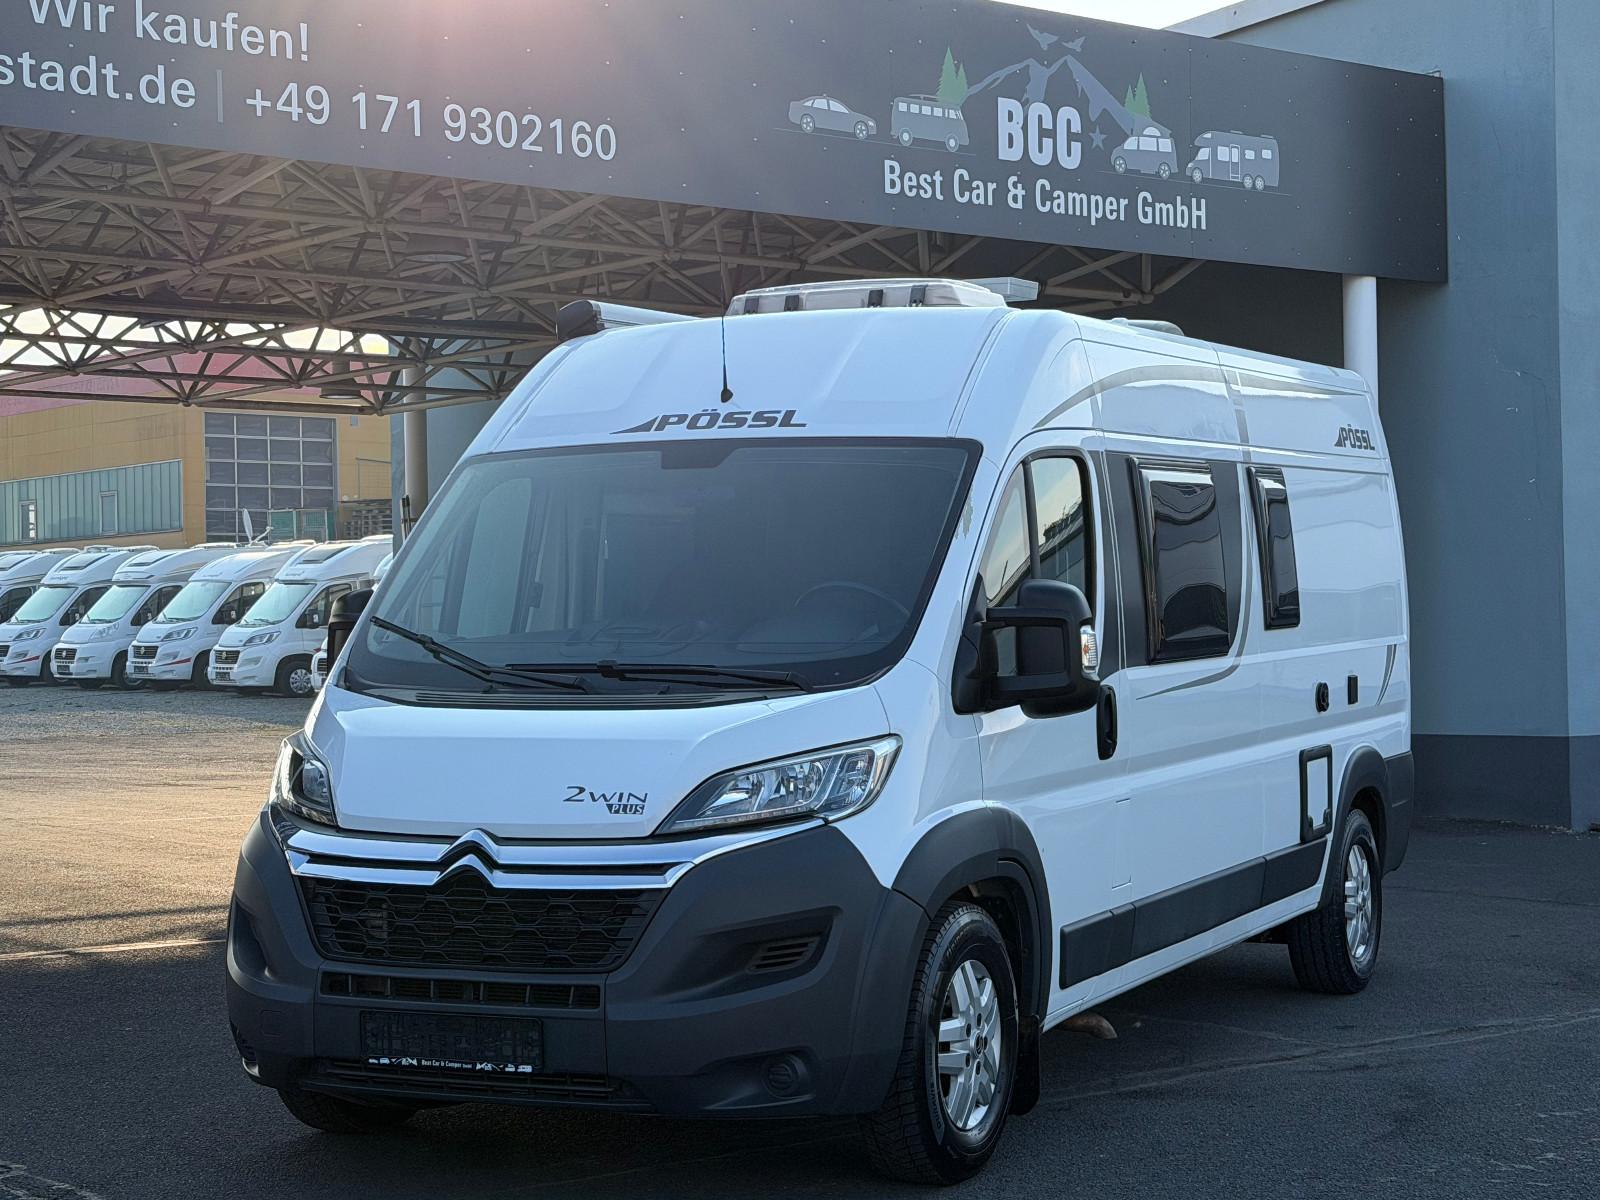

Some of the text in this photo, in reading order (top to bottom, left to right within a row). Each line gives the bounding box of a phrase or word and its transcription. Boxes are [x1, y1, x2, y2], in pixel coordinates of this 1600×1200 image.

[29, 0, 308, 61] Wir kaufen!
[0, 52, 617, 161] stadt.de +49 171 9302160
[997, 97, 1082, 169] BCC
[884, 160, 1207, 230] Best Car & Camper GmbH
[653, 408, 807, 431] PÖSSL
[611, 804, 644, 815] PLUS
